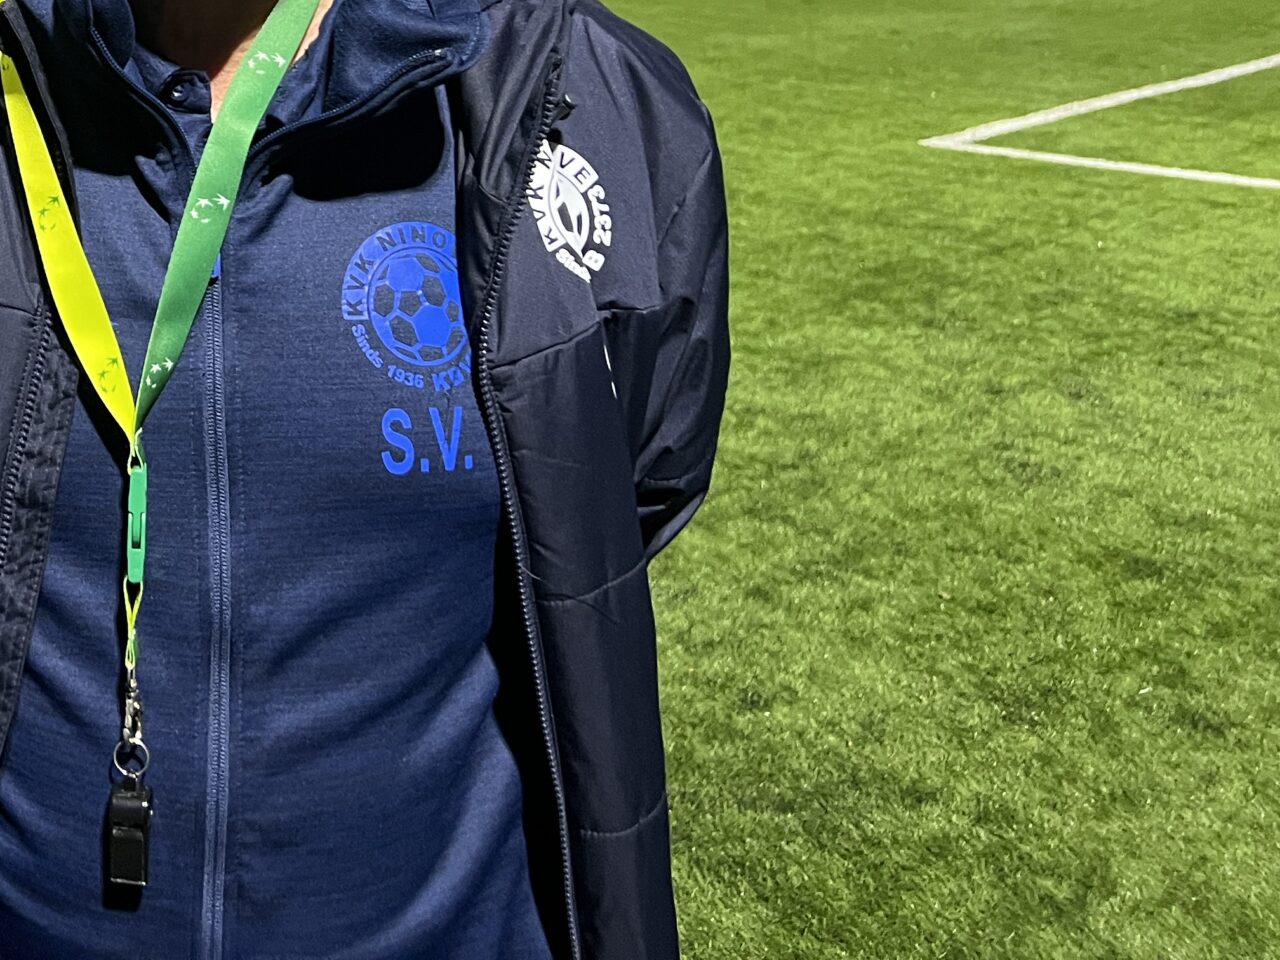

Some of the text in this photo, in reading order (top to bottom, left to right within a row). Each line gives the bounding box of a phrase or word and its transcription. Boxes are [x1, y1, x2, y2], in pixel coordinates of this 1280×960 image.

[345, 225, 448, 317] KVK NINO
[386, 364, 425, 389] 1936
[381, 406, 474, 476] S.V.
